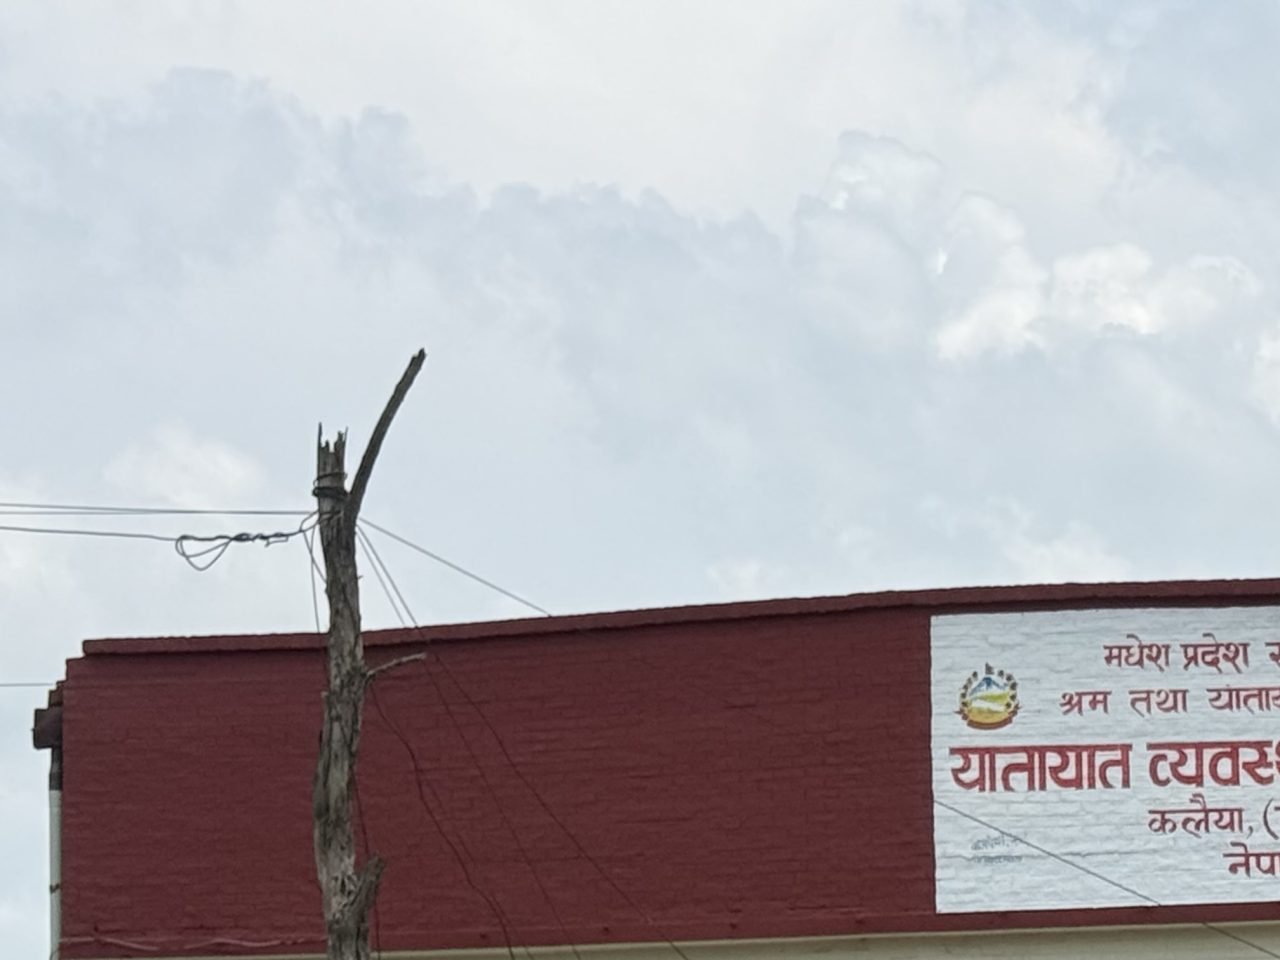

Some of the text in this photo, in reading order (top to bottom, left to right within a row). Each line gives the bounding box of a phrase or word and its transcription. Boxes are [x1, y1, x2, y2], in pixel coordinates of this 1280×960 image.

[1103, 633, 1170, 673] मधेश
[1180, 632, 1251, 674] प्रदेश
[1060, 689, 1112, 716] श्रम
[1128, 688, 1188, 718] तथा
[949, 743, 1133, 792] यातायात
